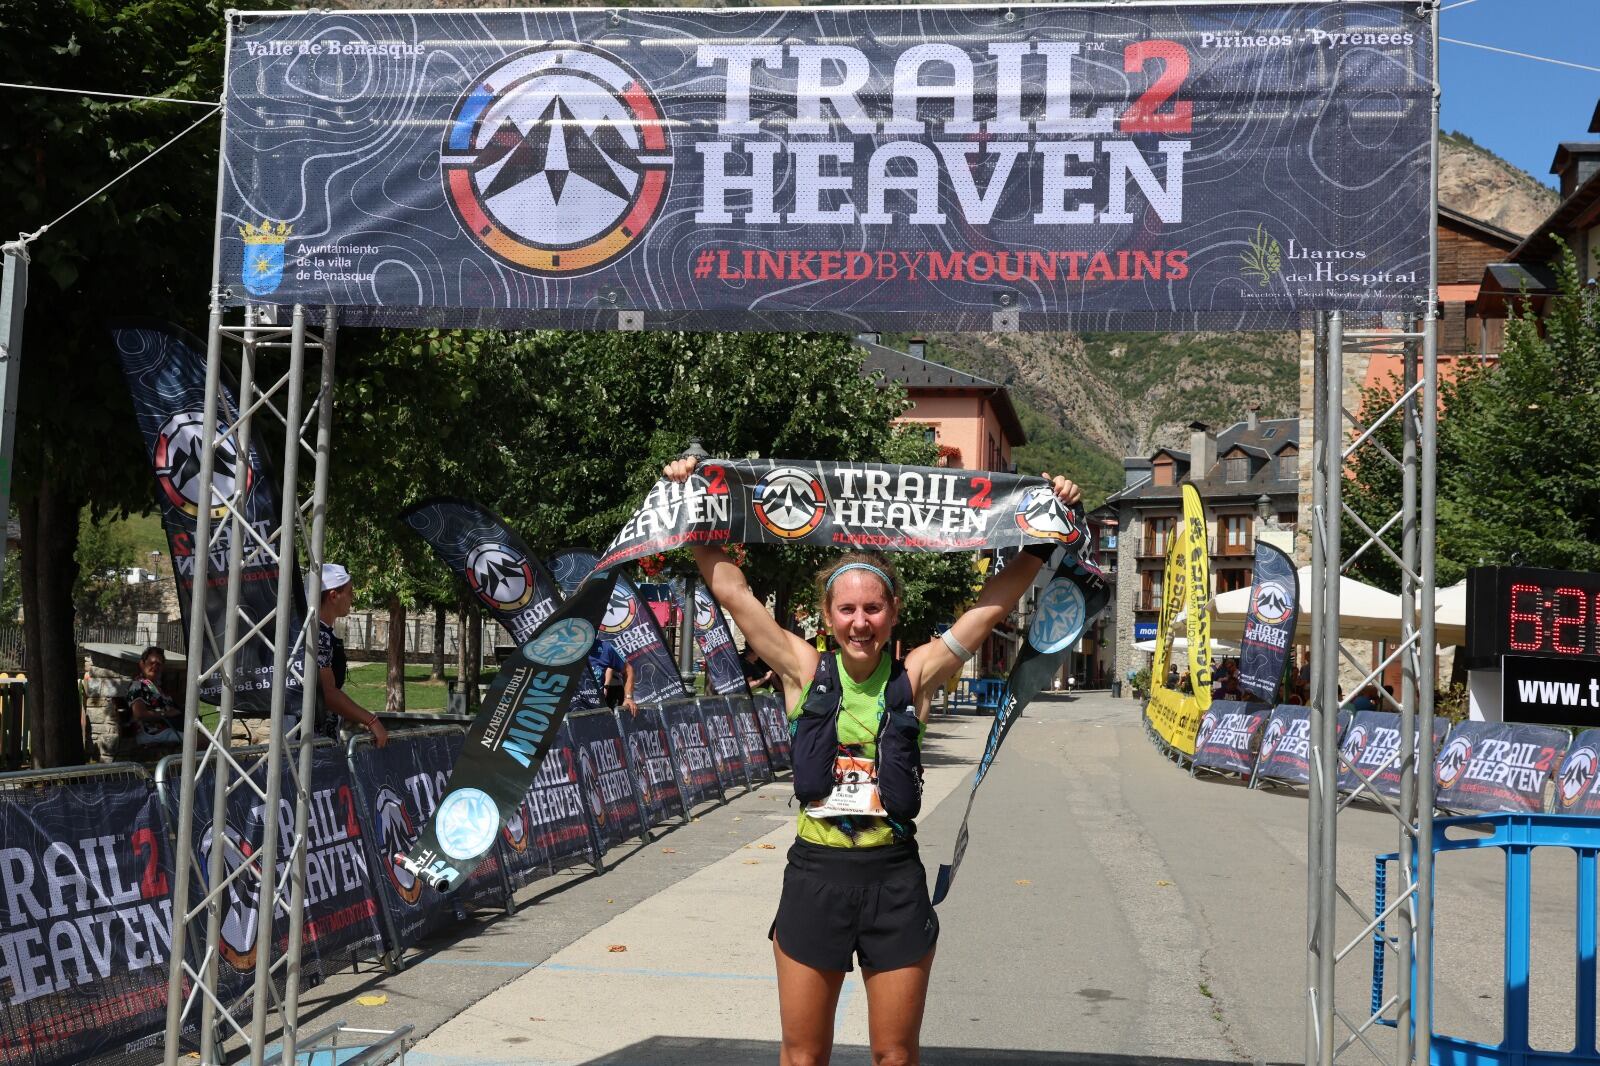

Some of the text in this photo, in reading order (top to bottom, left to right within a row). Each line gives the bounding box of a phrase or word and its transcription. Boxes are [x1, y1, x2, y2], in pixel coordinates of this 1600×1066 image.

[246, 40, 426, 60] Valle de Benasque
[1201, 31, 1293, 49] Pirineos
[1312, 29, 1414, 50] Pyrenees
[696, 42, 1113, 135] TRAIL
[1120, 40, 1192, 133] 2
[694, 141, 1192, 225] HEAVEN
[296, 257, 352, 268] de la villa
[297, 243, 379, 256] Ayuntamiento
[1287, 238, 1367, 260] Llanos
[296, 269, 373, 284] de Benasque
[694, 249, 1189, 282] #LINKEDBYMOUNTAINS
[1286, 261, 1418, 286] del Hospital
[704, 464, 728, 495] 2
[834, 468, 967, 506] TRAIL
[967, 477, 993, 509] 2
[832, 499, 991, 534] HEAVEN
[502, 671, 571, 769] SNOW
[1217, 713, 1253, 732] TRAIL
[1247, 716, 1261, 733] 2
[590, 738, 620, 772] TRAIL
[1208, 728, 1252, 750] HEAVEN
[1477, 739, 1556, 771] TRAIL 2
[1463, 758, 1546, 793] HEAVEN
[339, 784, 363, 838] 2
[527, 783, 586, 827] HEAVEN
[0, 834, 141, 928] RAIL
[131, 828, 169, 898] 2
